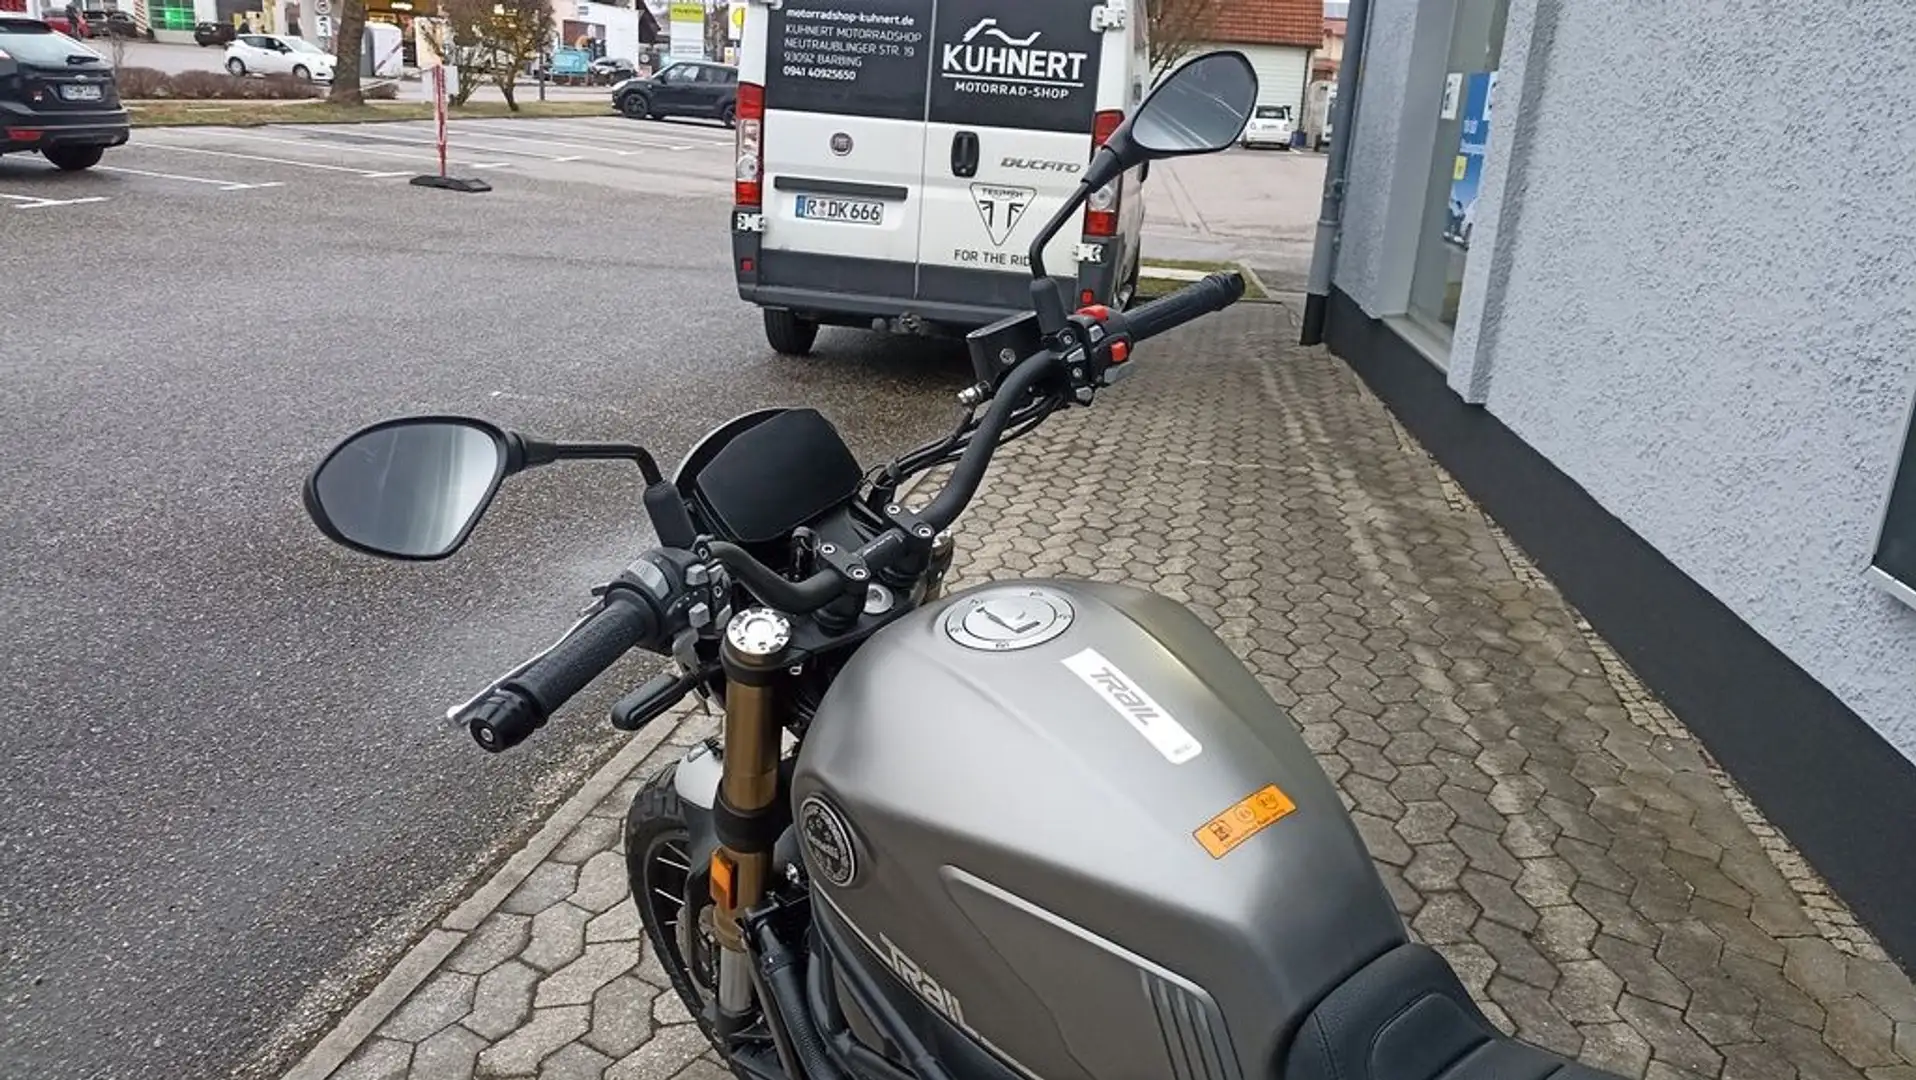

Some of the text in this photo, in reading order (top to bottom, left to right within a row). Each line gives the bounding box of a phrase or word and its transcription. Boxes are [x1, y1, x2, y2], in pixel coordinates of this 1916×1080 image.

[786, 9, 914, 26] motorradshop-kuhnert.de
[785, 24, 922, 43] KUHNERT MOTORRADSHOP
[784, 38, 876, 54] NEUTRAUBLINGER
[784, 51, 862, 68] 93092 BARBING
[943, 43, 1087, 80] KUHNERT
[783, 65, 857, 81] 0941 40925650
[955, 81, 1069, 99] MOTORRAD-SHOP
[1001, 158, 1080, 173] DUCATO
[806, 200, 881, 220] R DK 666
[954, 249, 1032, 267] FOR THE RID
